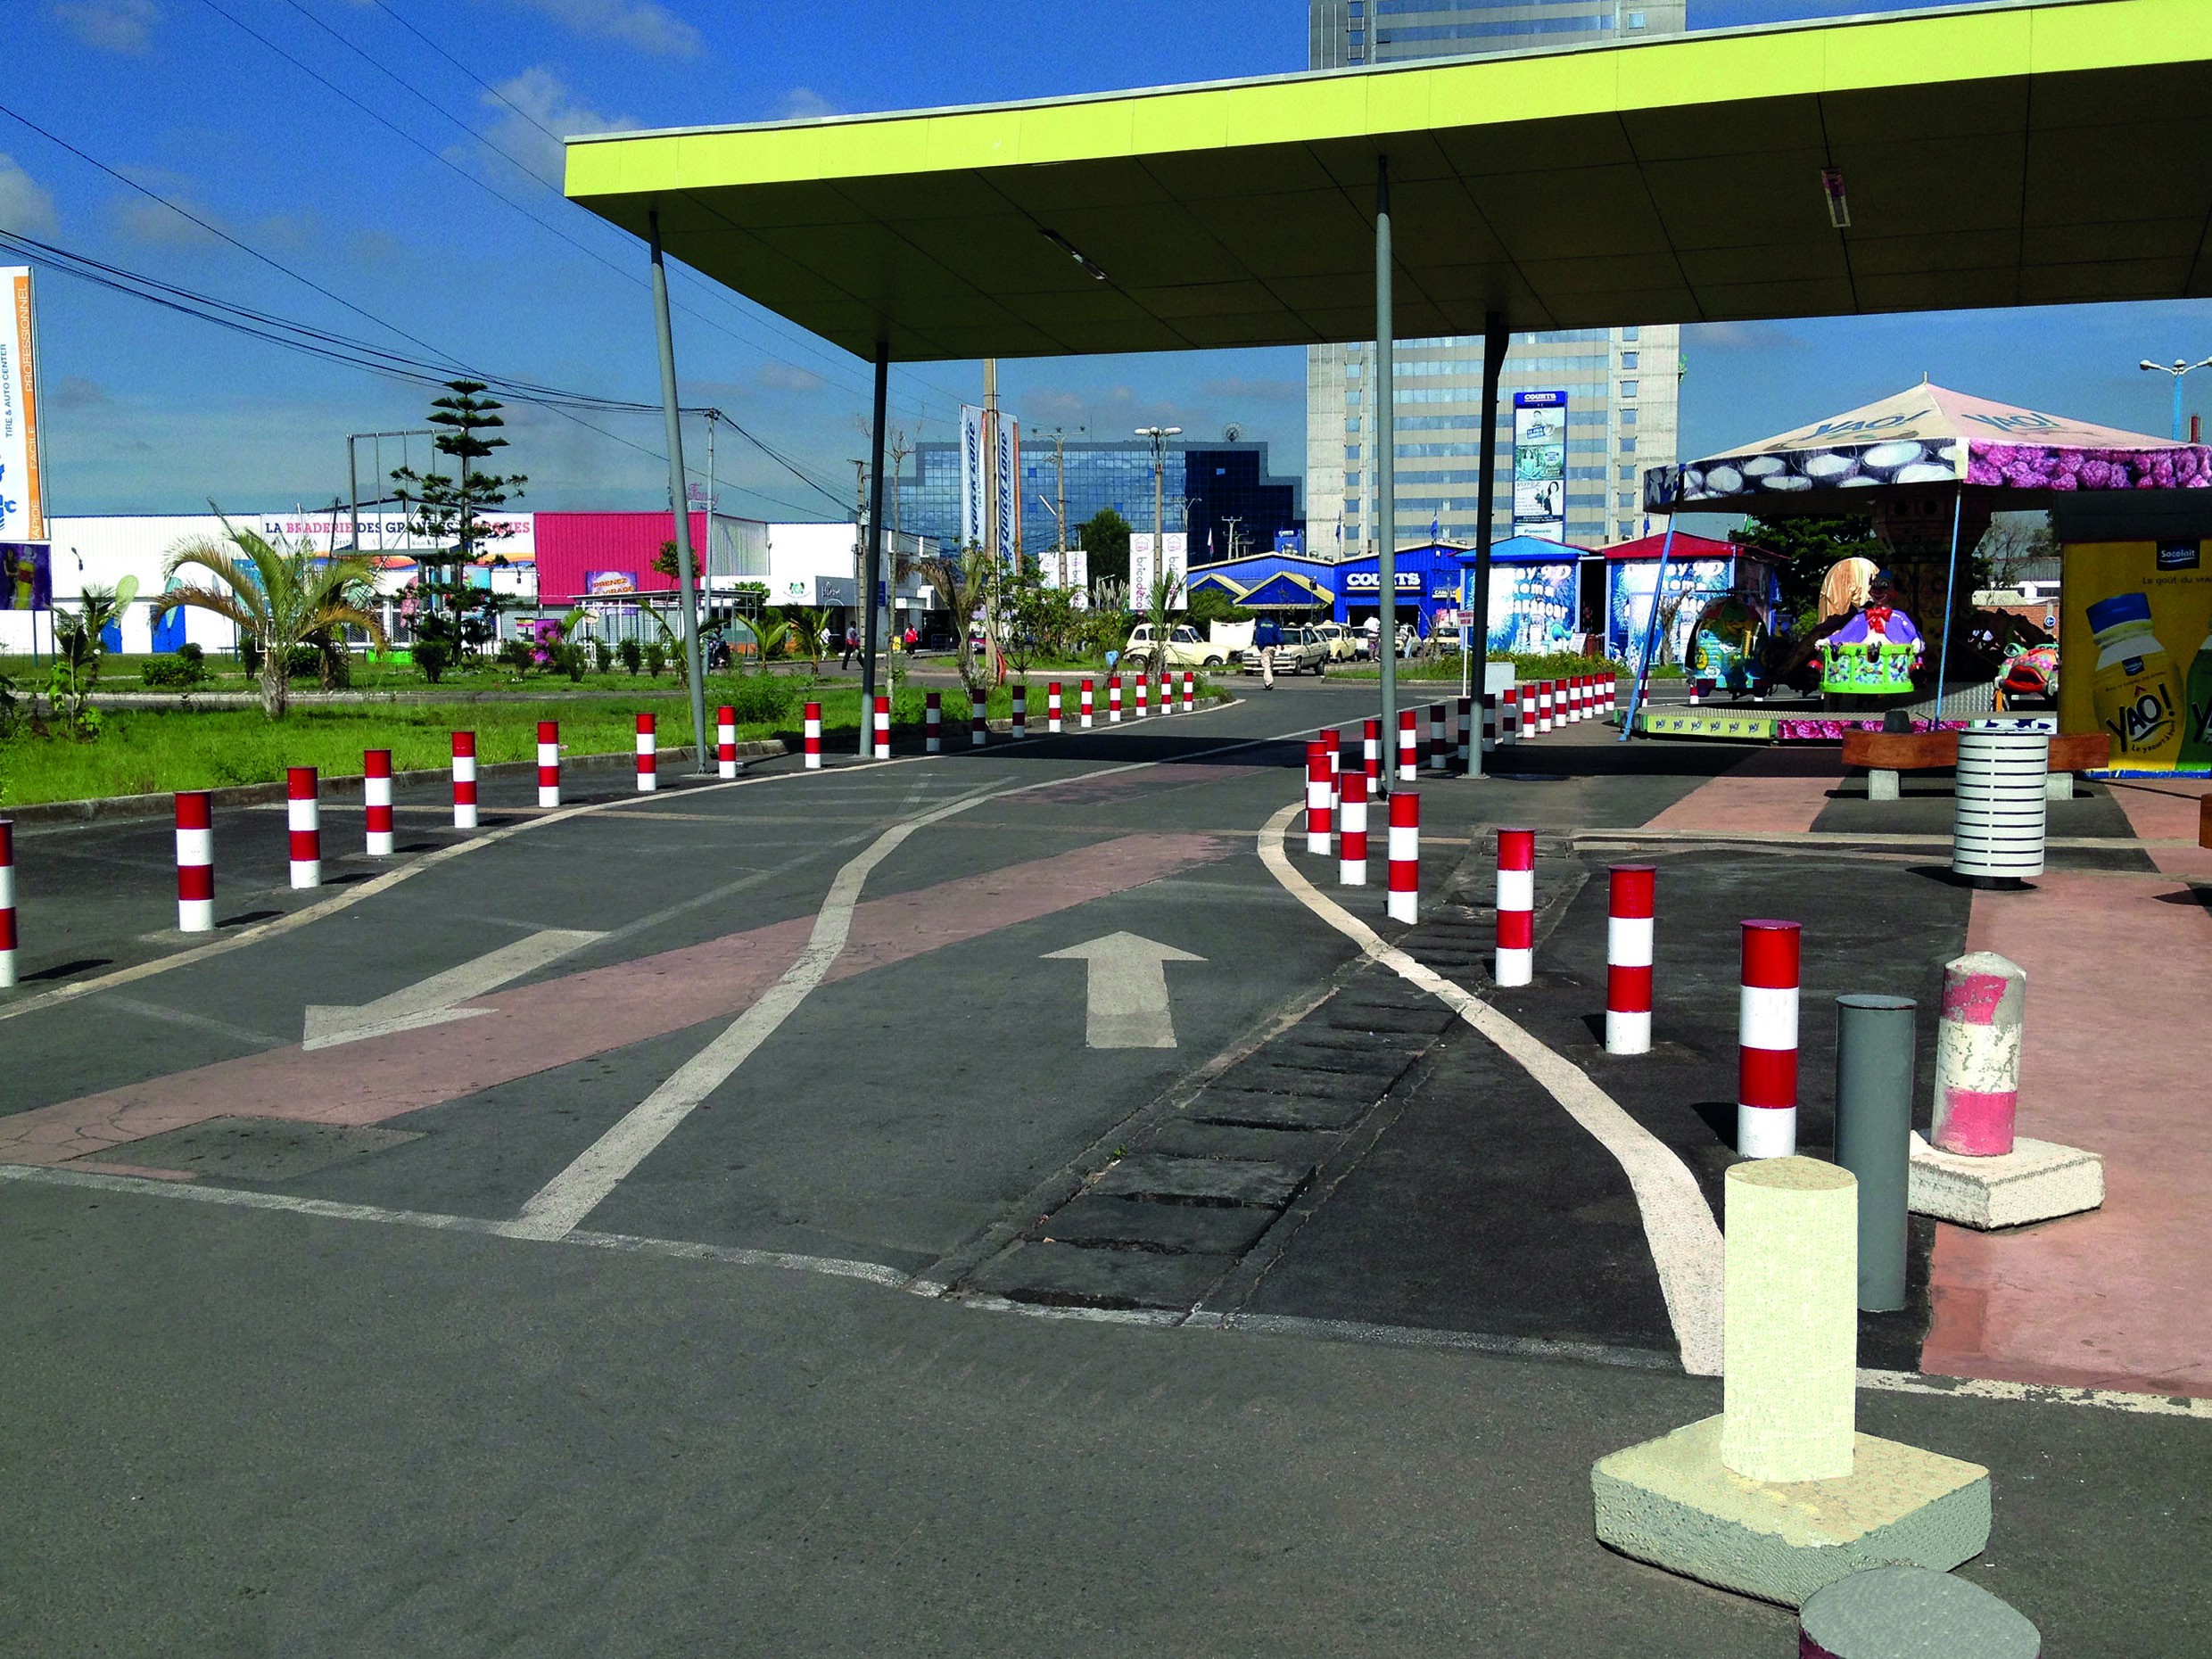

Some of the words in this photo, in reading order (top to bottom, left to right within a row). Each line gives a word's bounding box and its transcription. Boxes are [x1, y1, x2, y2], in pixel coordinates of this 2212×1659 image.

[18, 284, 33, 392] PROFESSIONNEL
[0, 343, 9, 381] CENTER
[3, 383, 12, 409] AUTO
[29, 425, 37, 469] FACILE
[999, 431, 1008, 483] Lane
[999, 487, 1009, 542] Quick
[266, 523, 282, 533] LA
[286, 523, 352, 533] BRADERIE
[358, 523, 381, 533] DES
[2161, 549, 2195, 558] Socolait
[594, 578, 628, 588] PRENEZ
[1347, 573, 1421, 586] COUTS
[2181, 575, 2192, 583] du
